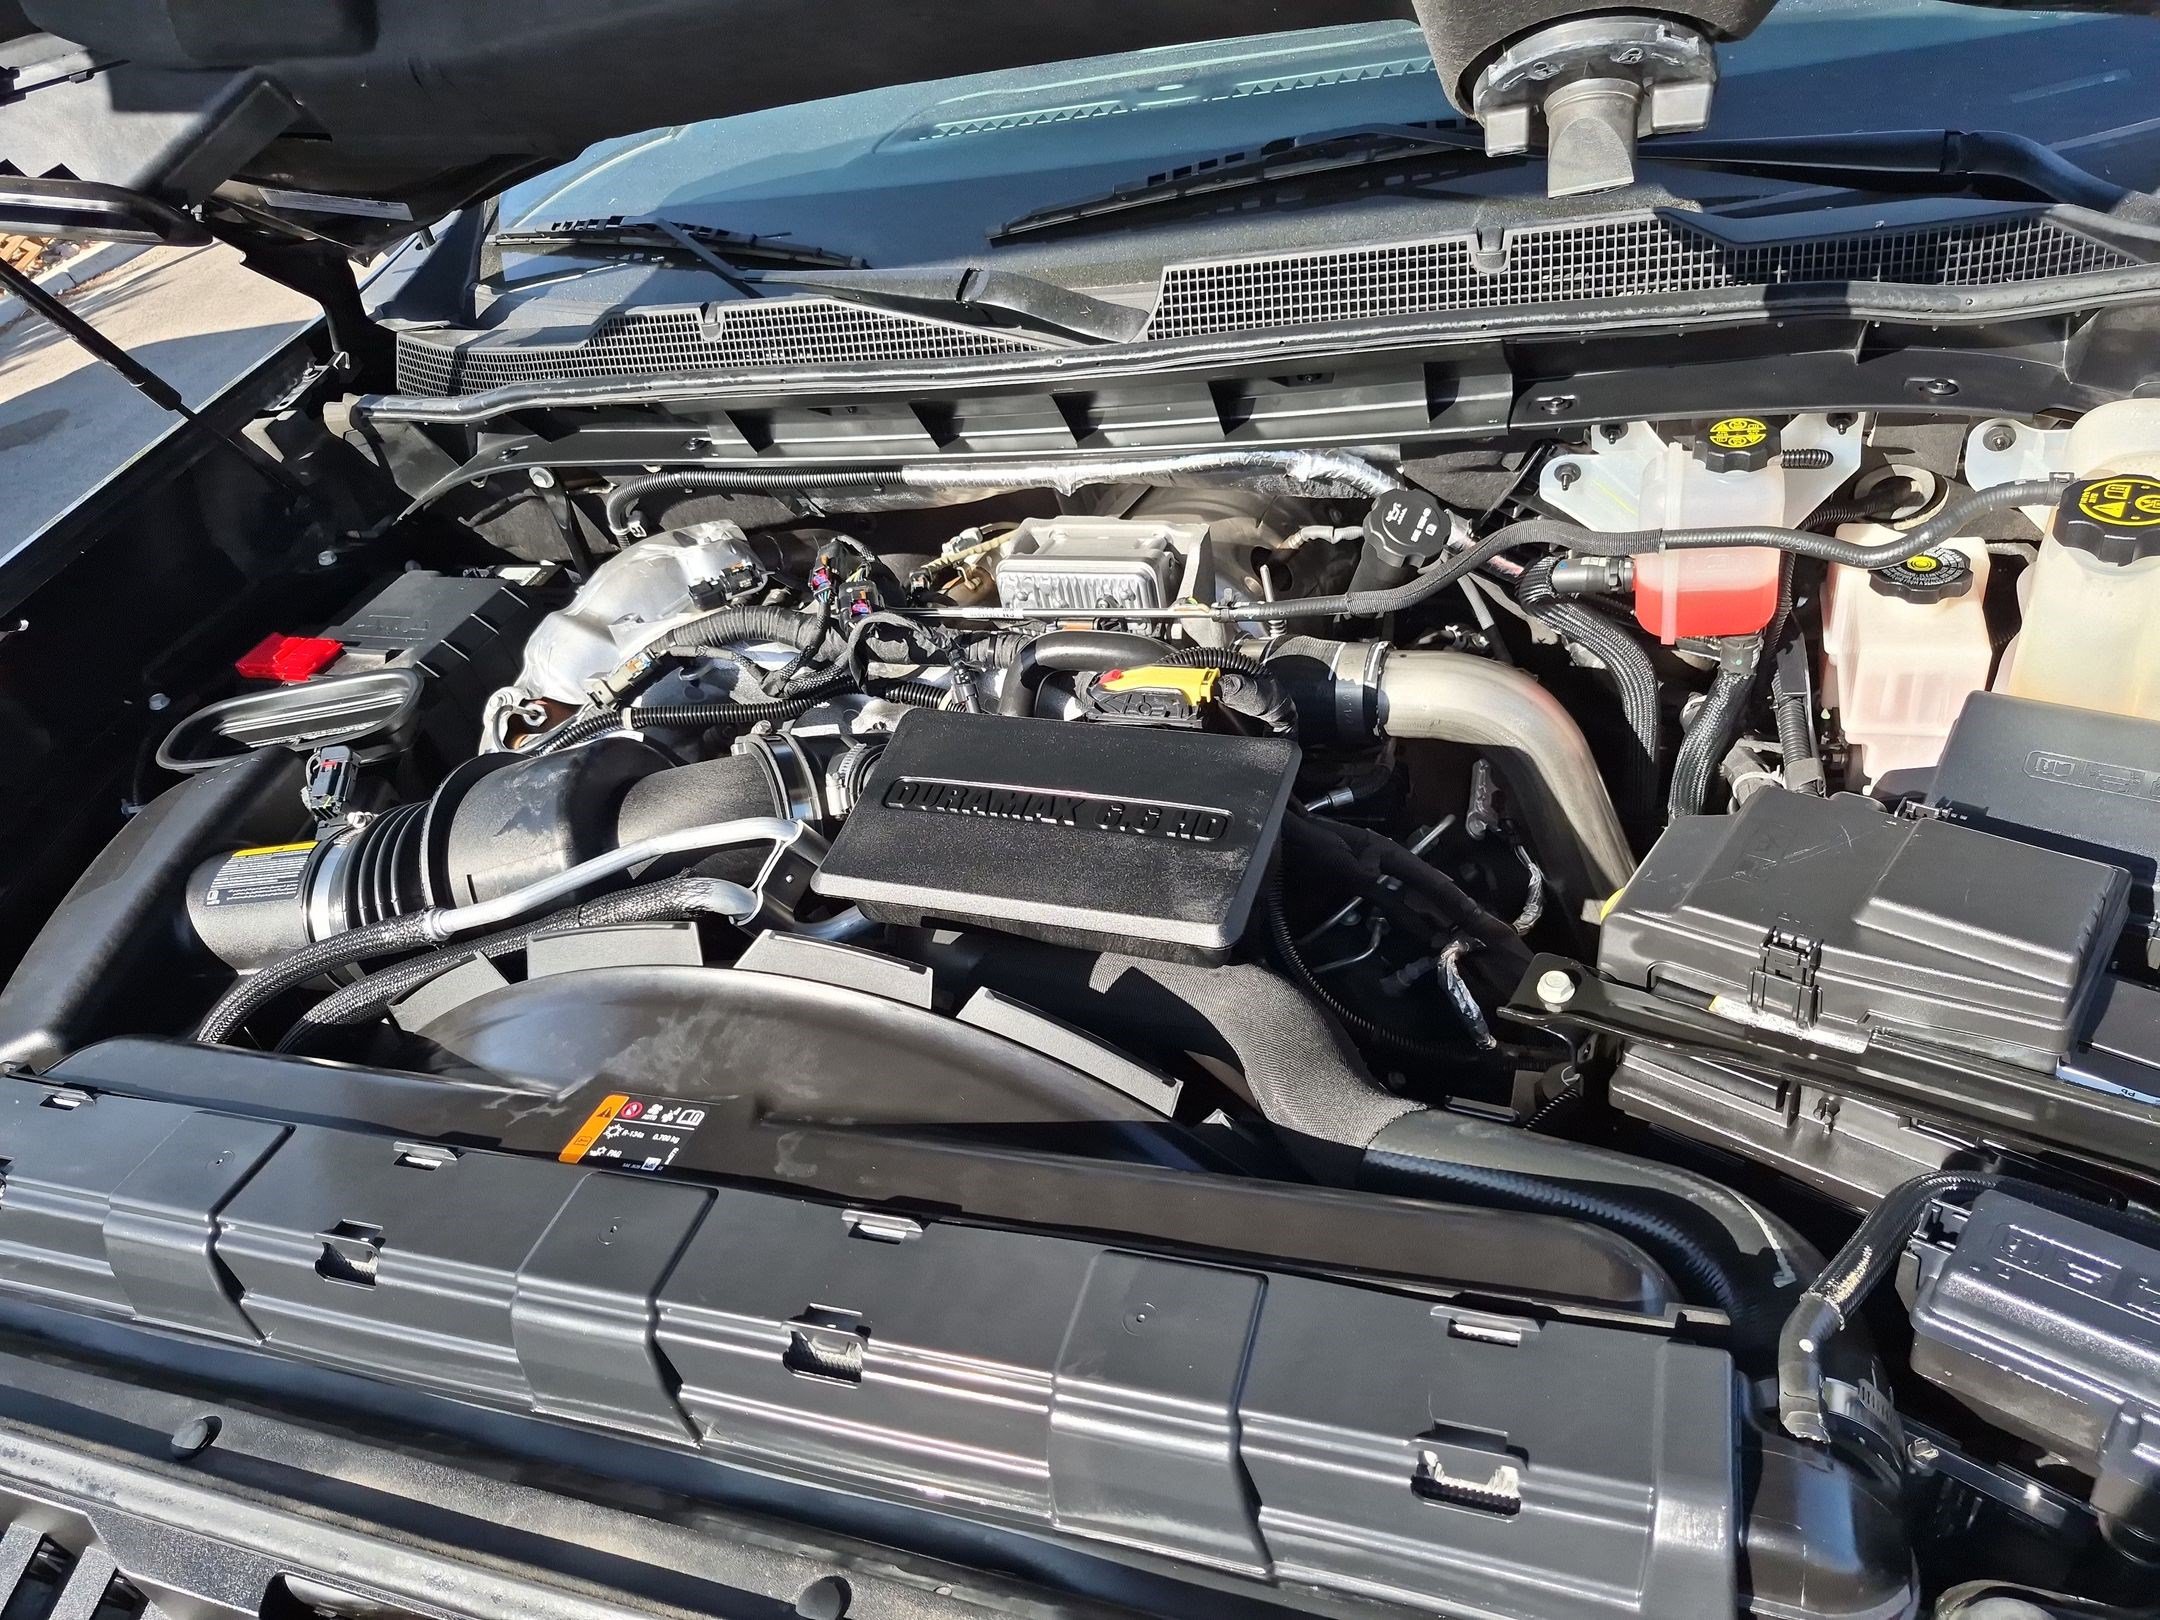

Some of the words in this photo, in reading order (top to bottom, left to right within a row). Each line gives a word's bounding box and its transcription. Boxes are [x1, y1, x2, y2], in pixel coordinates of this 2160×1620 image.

[888, 782, 1084, 825] DURAMAX
[1096, 801, 1163, 834] 6.6
[1165, 808, 1230, 842] HD
[622, 1129, 645, 1138] R-134a
